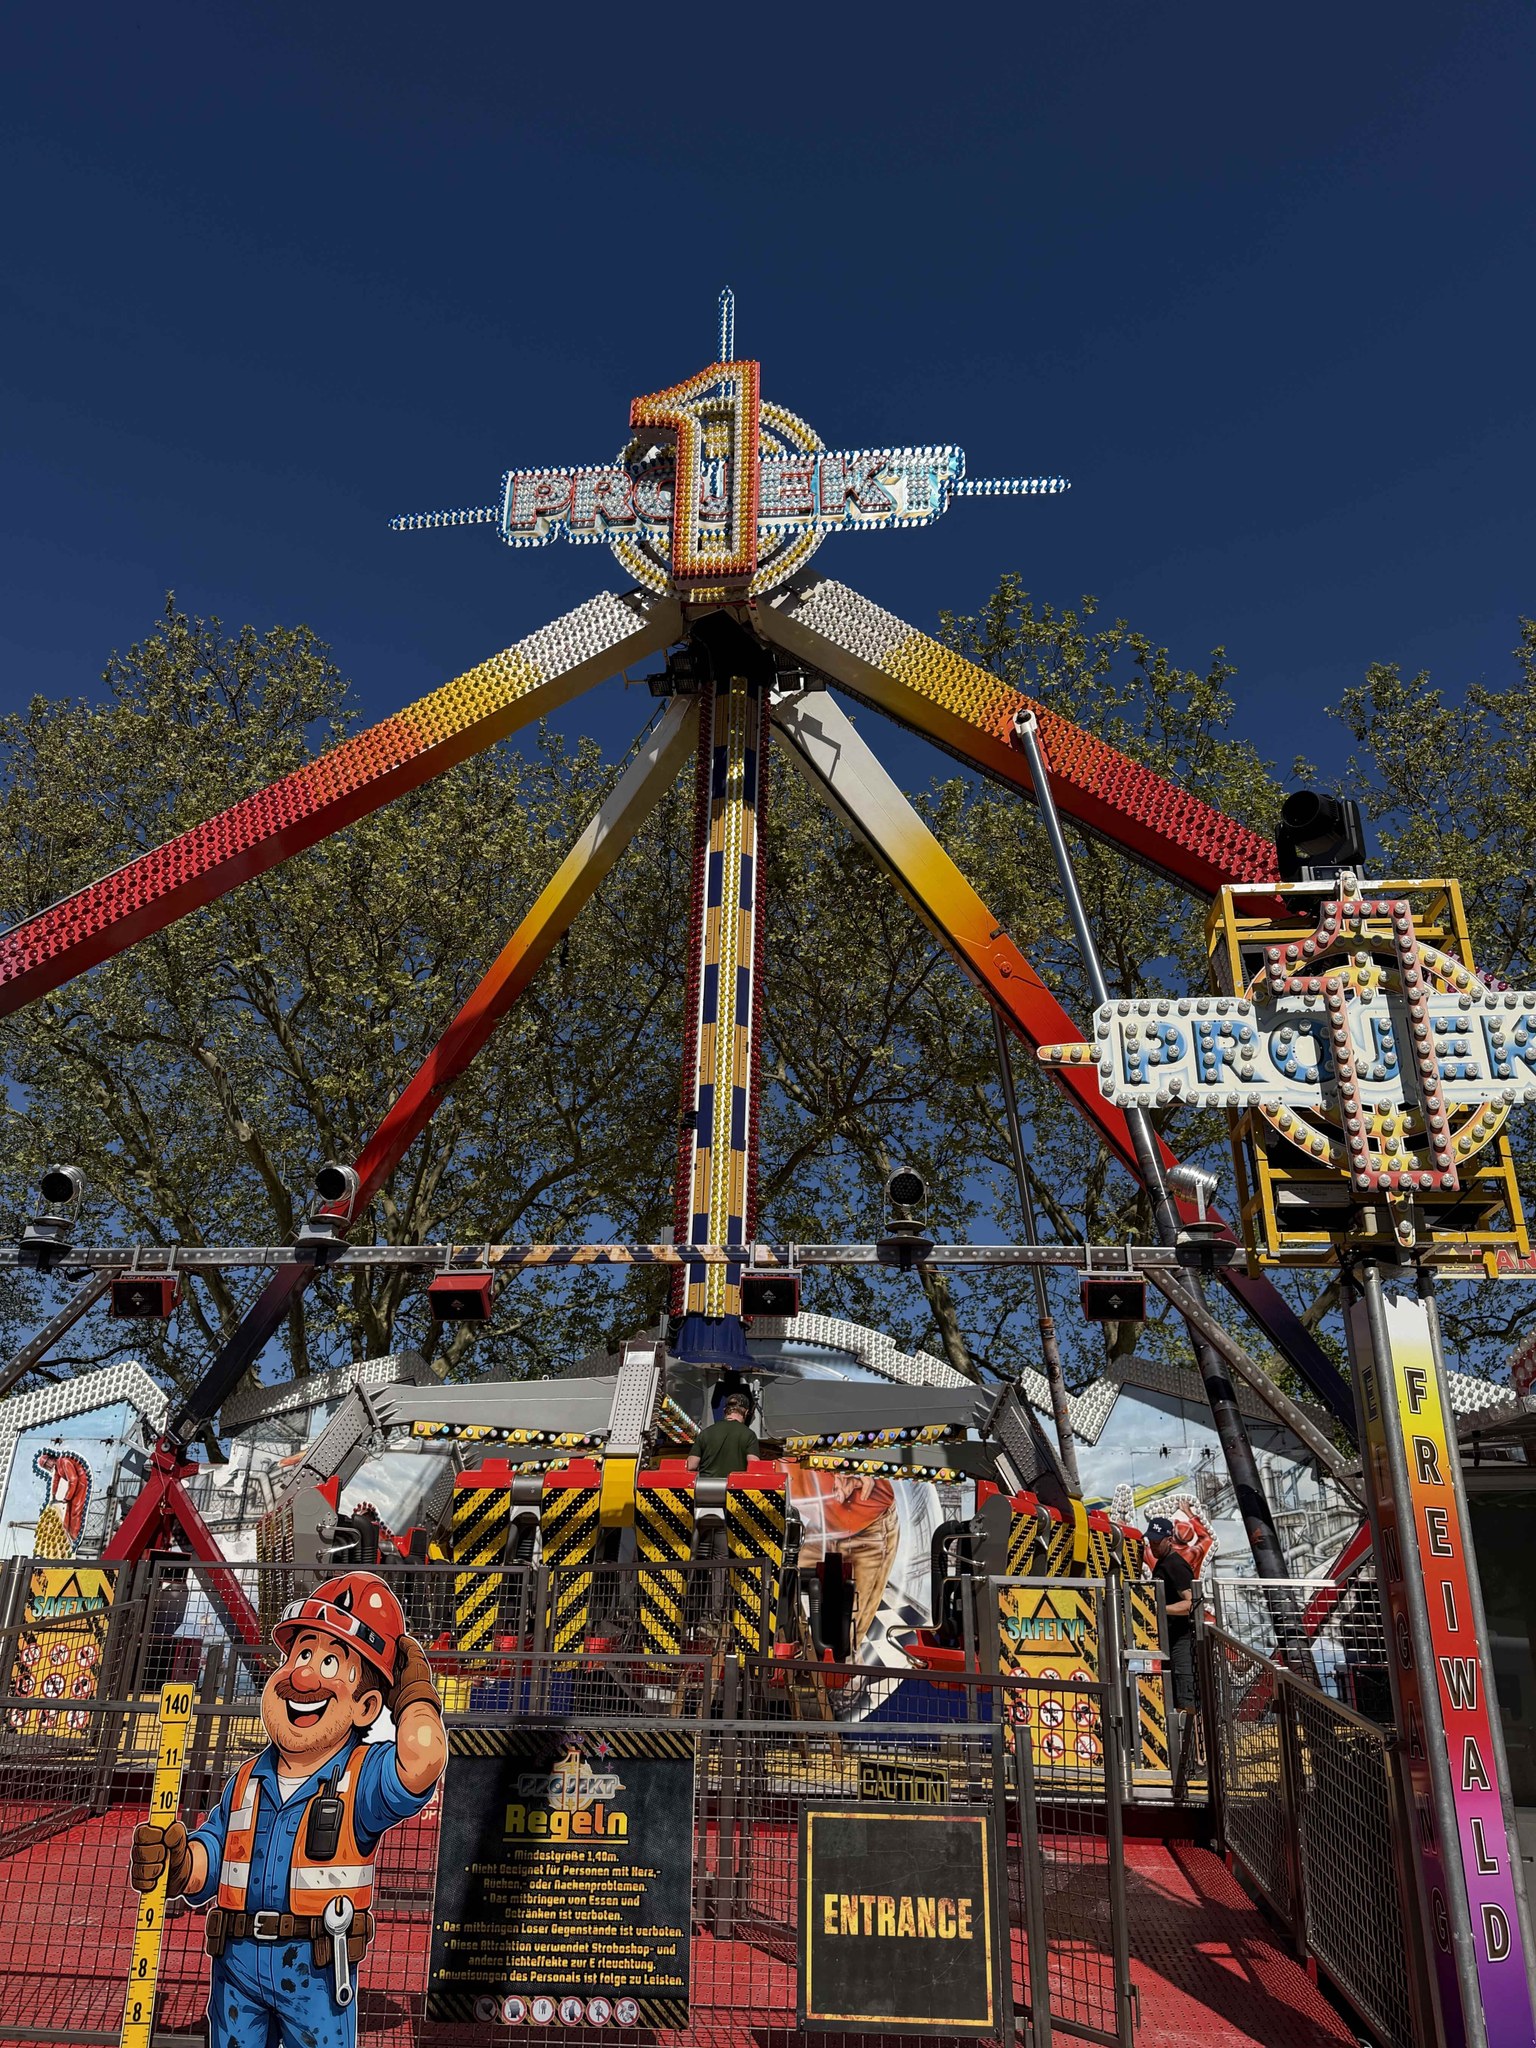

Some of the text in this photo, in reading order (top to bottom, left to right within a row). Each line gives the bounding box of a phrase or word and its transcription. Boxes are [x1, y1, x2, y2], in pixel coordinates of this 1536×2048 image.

[630, 360, 760, 582] 1
[511, 456, 948, 530] PROJEKT
[1263, 900, 1460, 1192] 1
[1007, 1616, 1084, 1641] SAFETY!
[1403, 1366, 1512, 1962] FREIWALD
[165, 1694, 189, 1715] 140
[166, 1749, 178, 1766] 11
[521, 1777, 615, 1795] PROJEKT
[862, 1767, 941, 1804] CAUTION
[160, 1791, 172, 1809] 10
[504, 1803, 628, 1839] Regeln
[514, 1850, 620, 1863] Mindestgröße 1,40m.
[545, 1865, 561, 1876] für
[562, 1865, 610, 1876] Personen
[611, 1866, 630, 1877] mit
[530, 1878, 552, 1890] oder
[553, 1879, 648, 1893] Nackenproblemen.
[490, 1892, 641, 1907] Das mitbringen von Essen und
[145, 1908, 154, 1928] 9
[504, 1907, 624, 1921] Getränken ist verboten.
[824, 1893, 973, 1940] ENTRANCE
[443, 1920, 685, 1938] Das mitbringen Loser Gegenstände ist verboten.
[450, 1938, 677, 1957] Diese Attraktion verwendet Stroboskop- und
[138, 1958, 147, 1977] 8
[469, 1954, 504, 1966] andere
[506, 1955, 569, 1968] Lichteffekte
[570, 1959, 587, 1968] zur
[439, 1968, 685, 1987] Anweisungen des Personals ist folge zu Leisten.
[133, 2002, 142, 2022] 8
